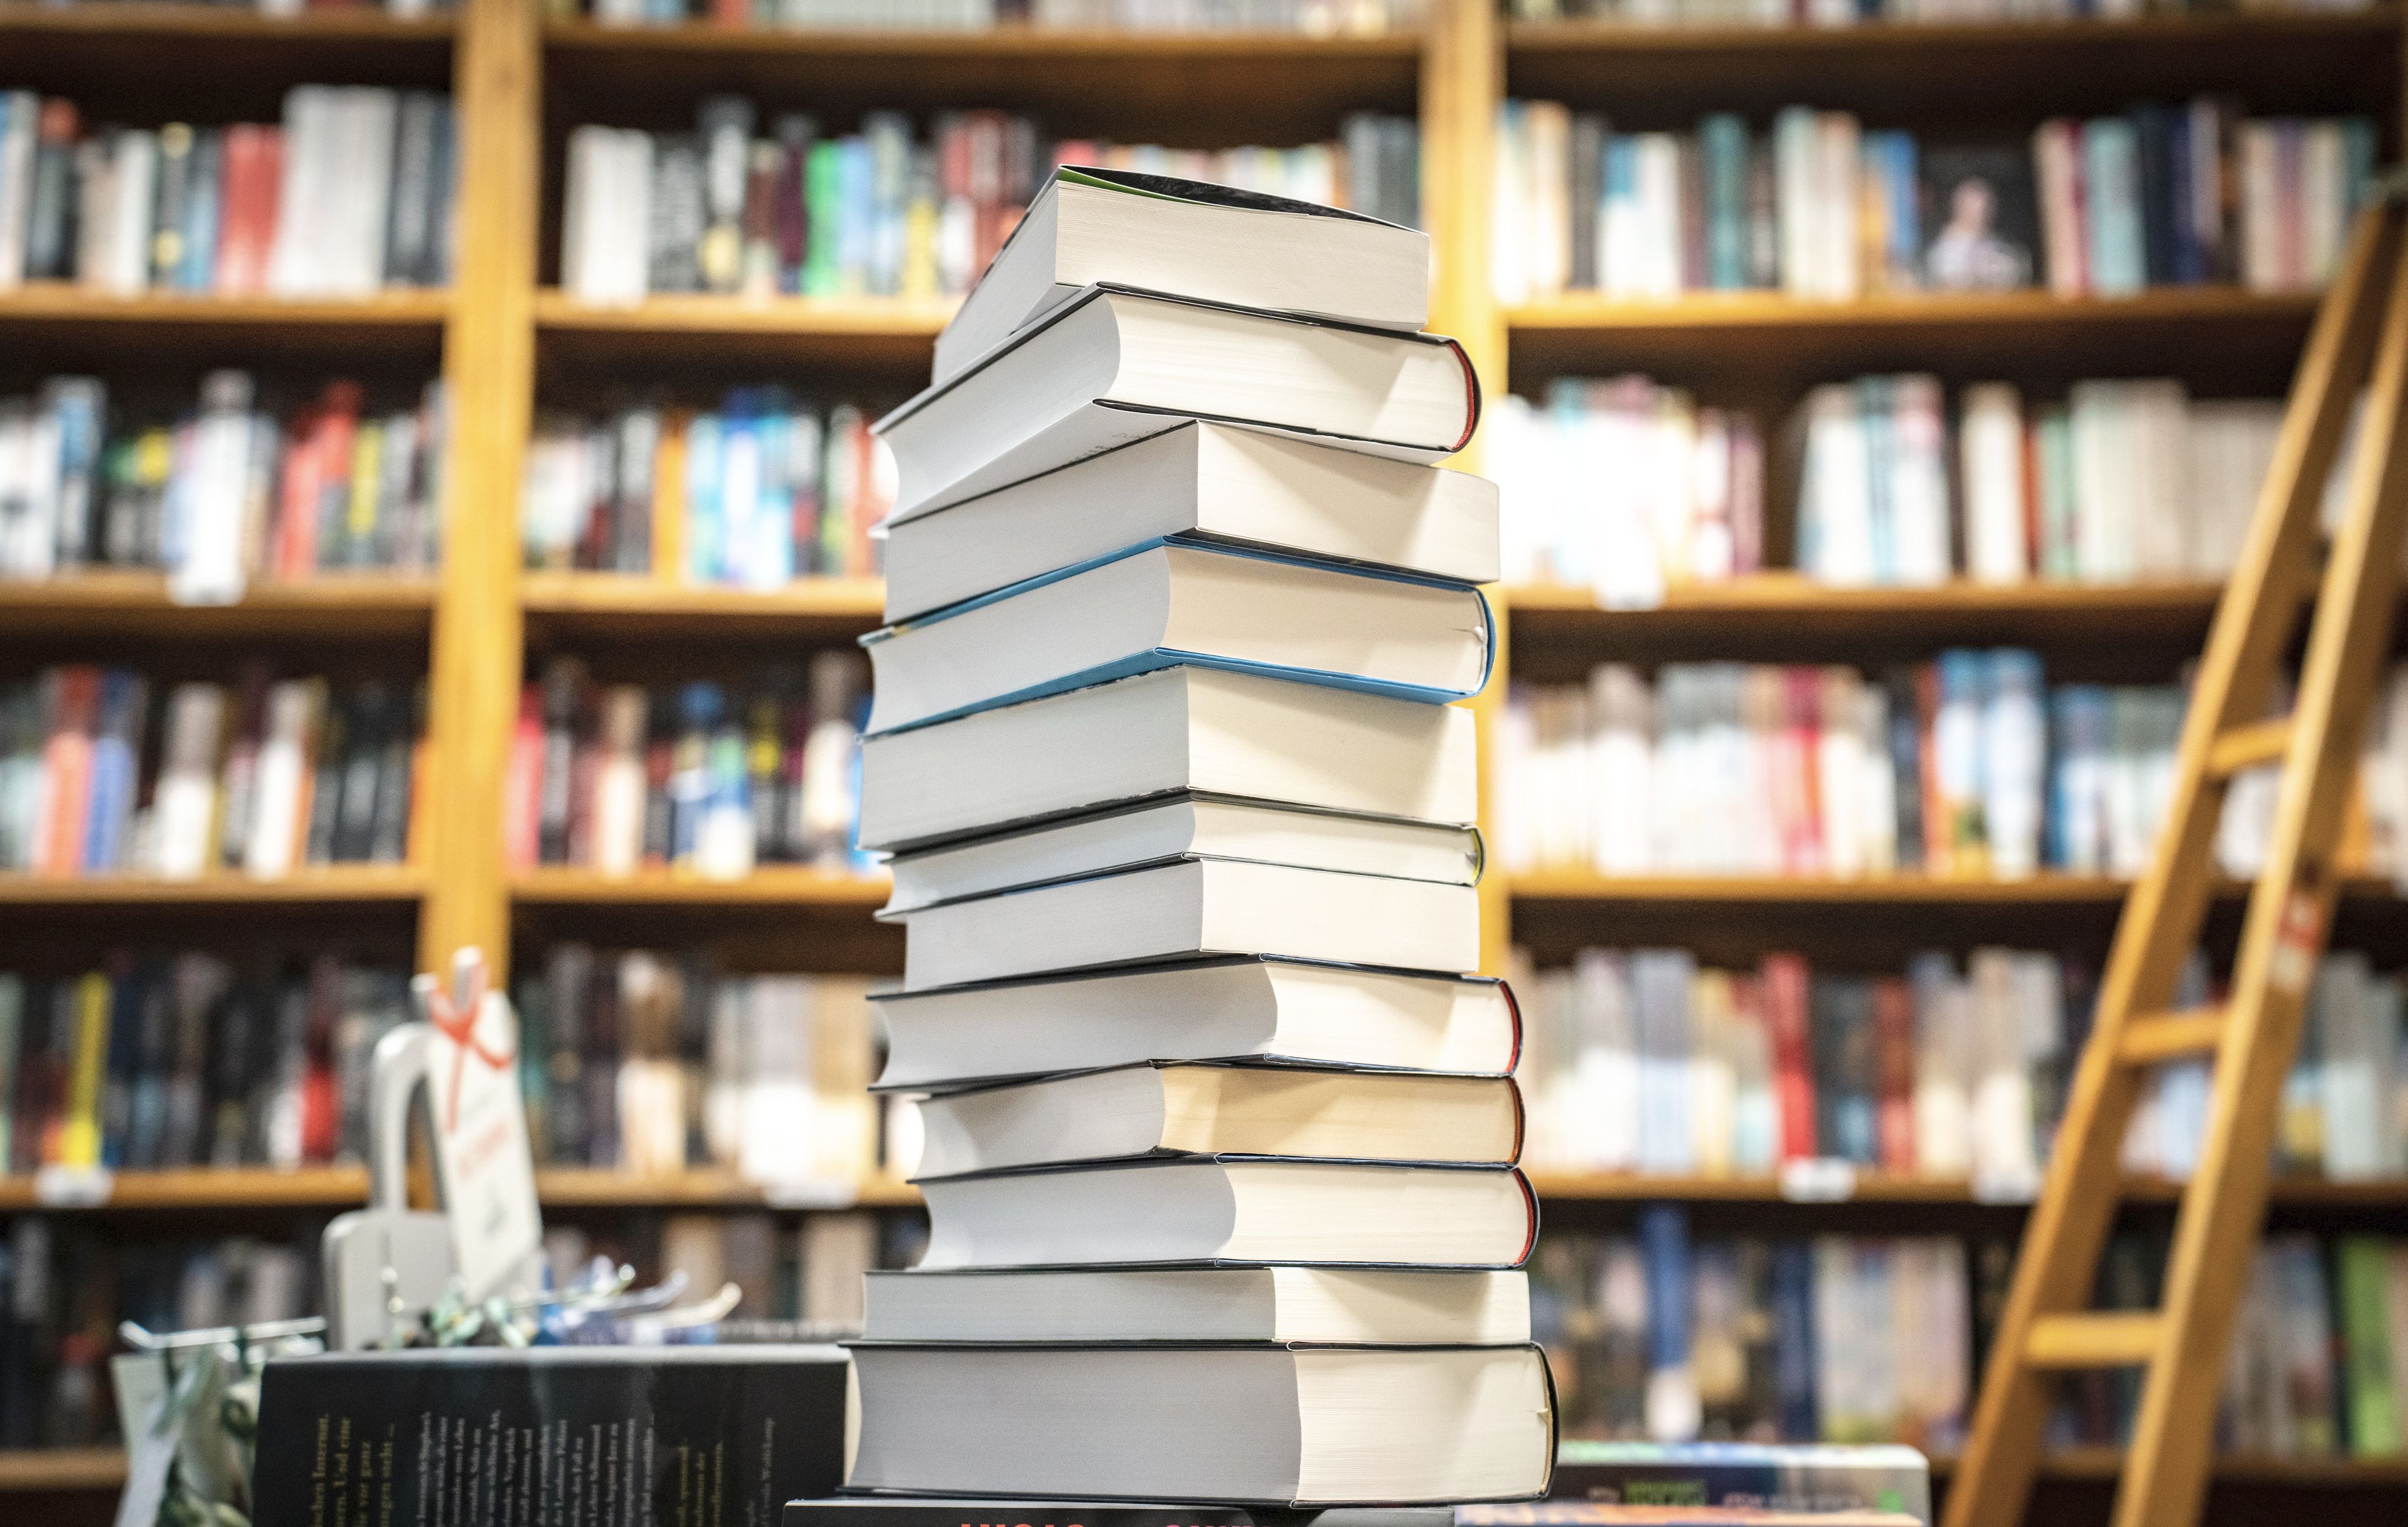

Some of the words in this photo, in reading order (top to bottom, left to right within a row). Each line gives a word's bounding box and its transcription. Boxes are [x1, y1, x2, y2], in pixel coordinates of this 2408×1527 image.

[337, 1418, 350, 1449] eine
[333, 1453, 349, 1487] Und
[360, 1441, 373, 1478] ganz
